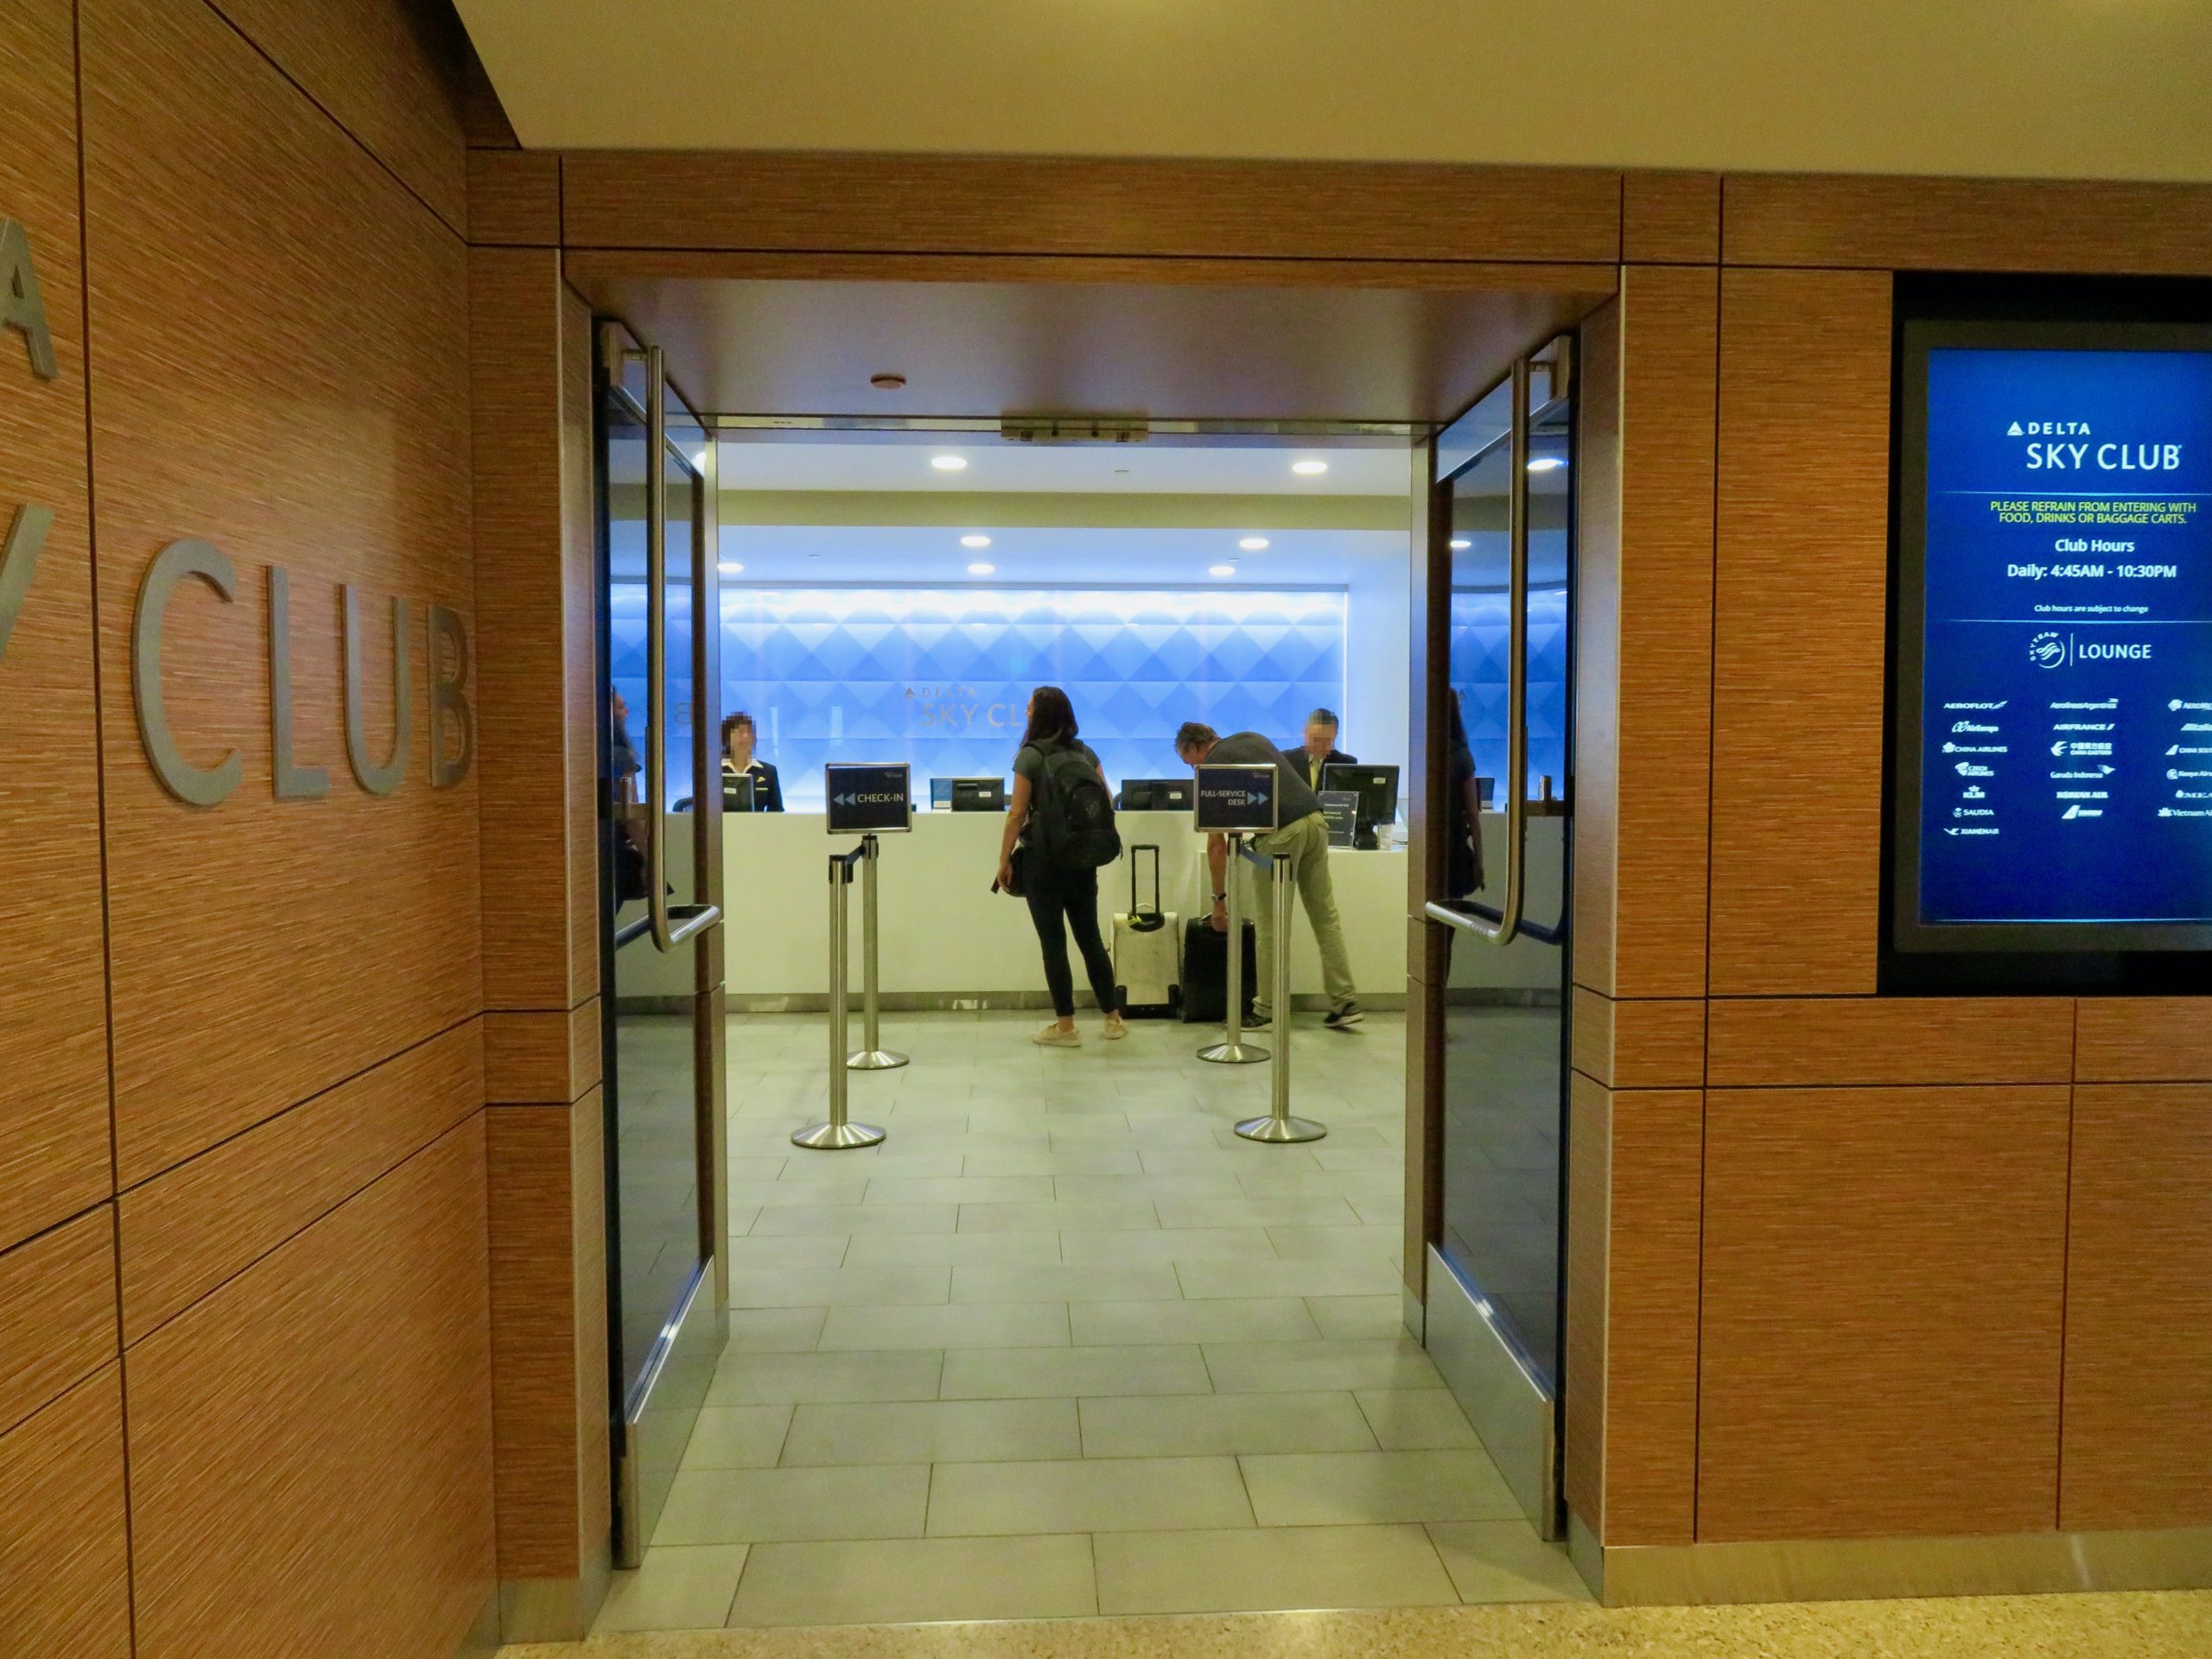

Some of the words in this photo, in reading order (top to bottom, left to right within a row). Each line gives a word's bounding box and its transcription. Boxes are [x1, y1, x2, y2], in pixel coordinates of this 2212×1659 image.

[2028, 422, 2091, 435] DELTA
[2026, 442, 2089, 469] SKY
[2097, 443, 2180, 470] CLUB
[1990, 500, 2029, 512] PLEASE
[2031, 501, 2075, 512] REFRAIN
[2078, 501, 2110, 512] FROM
[2113, 502, 2166, 512] ENTERING
[2168, 502, 2196, 512] WITH
[1999, 512, 2033, 524] FOOD,
[2036, 512, 2076, 523] DRINKS
[2078, 512, 2094, 524] OR
[2096, 513, 2149, 524] BAGGAGE
[2151, 513, 2188, 524] CARTS.
[2055, 538, 2088, 552] Club
[2091, 540, 2135, 552] Hours
[2007, 564, 2048, 581] Daily:
[2050, 564, 2104, 578] 4:45AM
[2116, 565, 2177, 578] 10:30PM
[2087, 605, 2113, 614] subject
[2122, 605, 2149, 614] change
[2079, 644, 2152, 659] LOUNGE
[130, 536, 475, 810] CLUB
[921, 703, 978, 727] SKY
[857, 793, 904, 803] CHECK-IN
